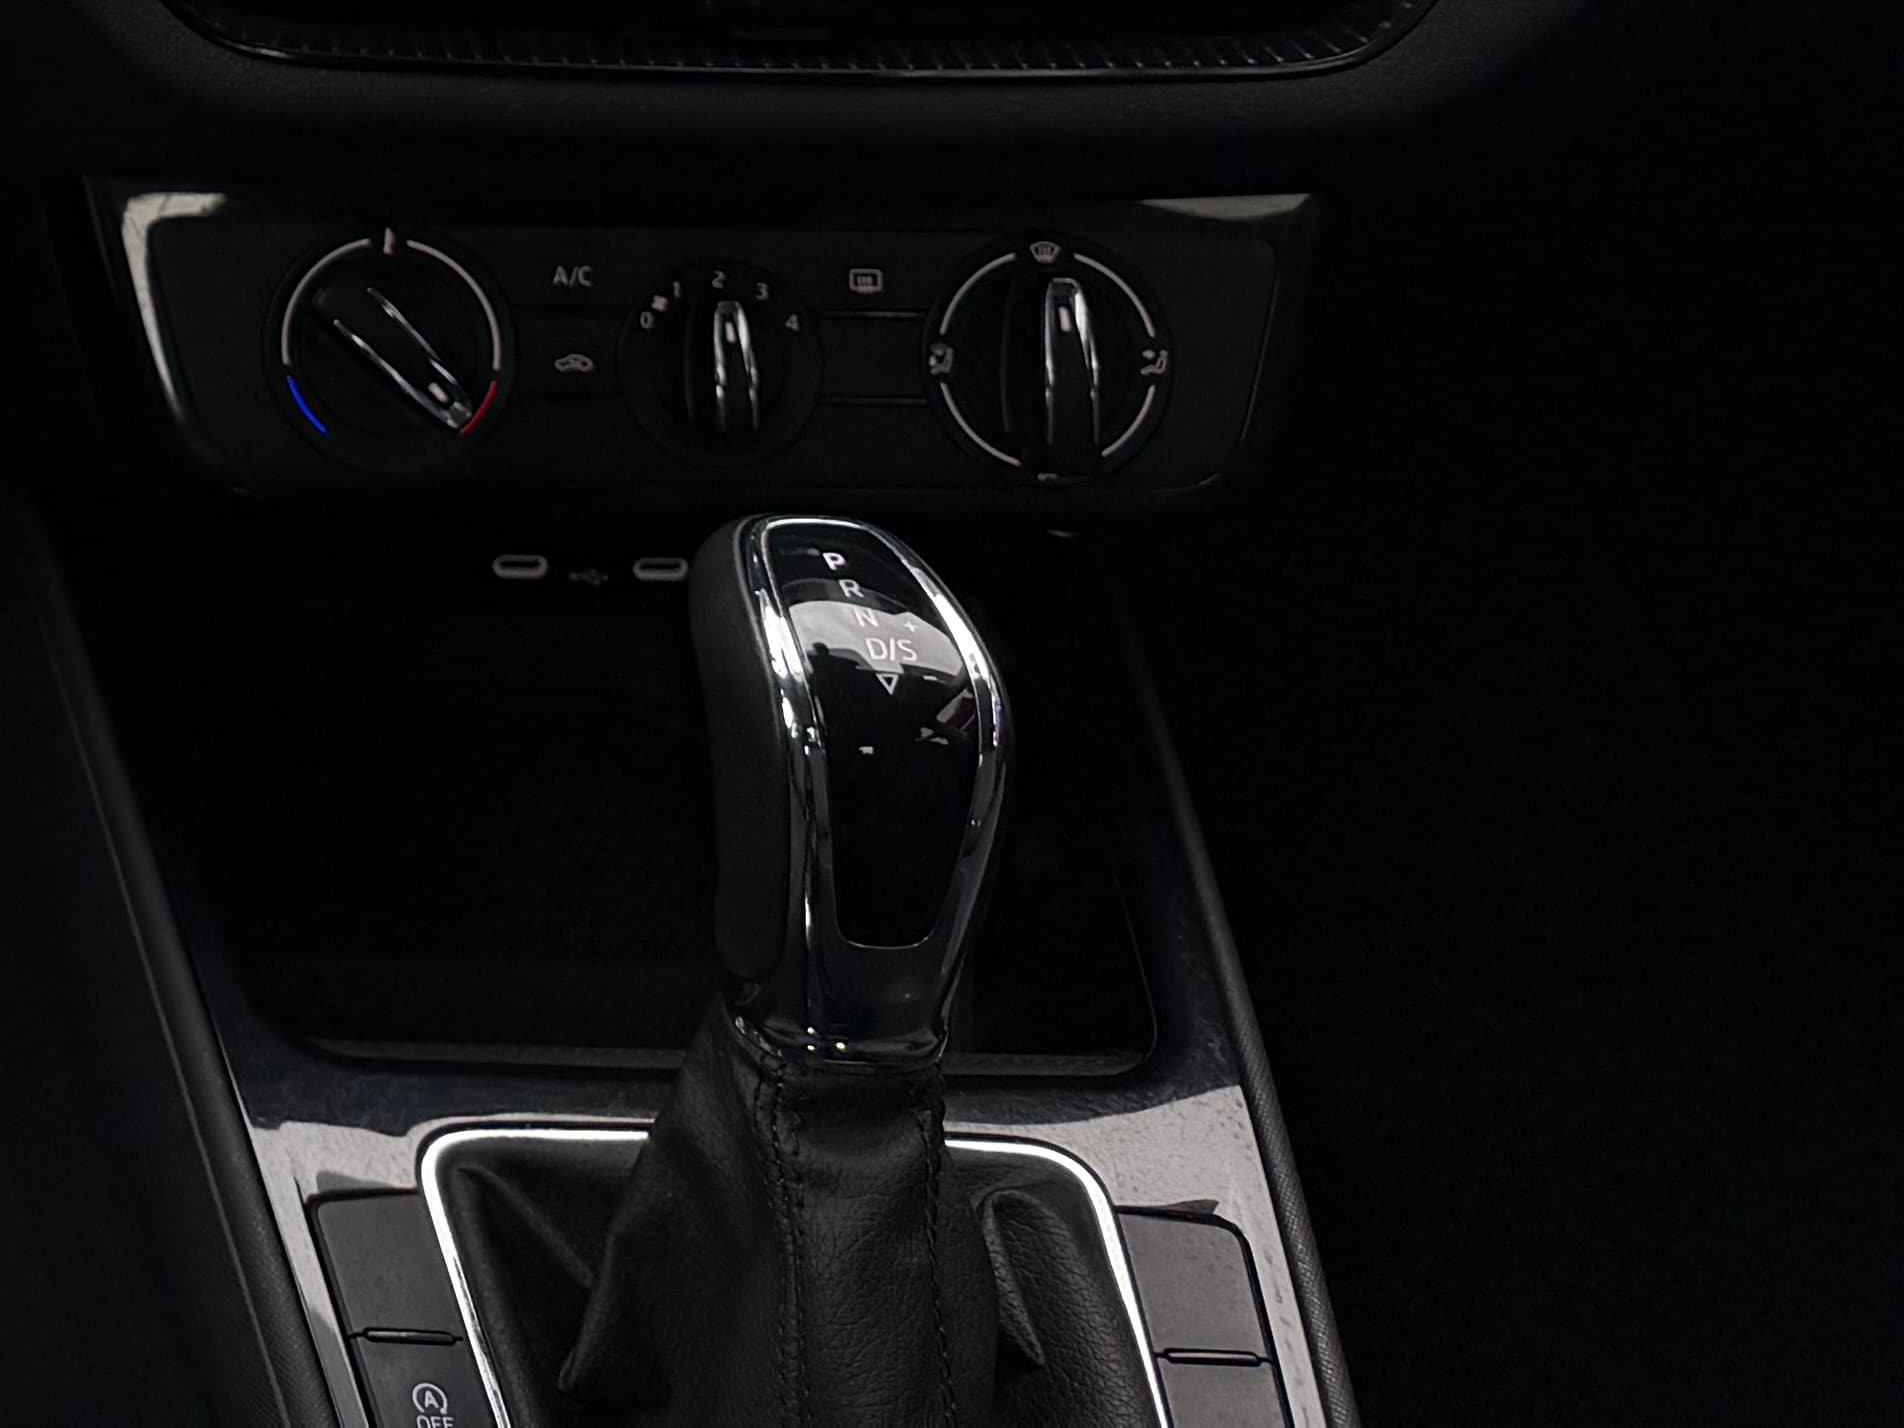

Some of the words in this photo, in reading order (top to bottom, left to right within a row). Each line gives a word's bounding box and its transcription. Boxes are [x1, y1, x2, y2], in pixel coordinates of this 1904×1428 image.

[552, 264, 593, 287] A/C
[711, 270, 726, 289] 2
[755, 281, 769, 301] 3
[784, 313, 800, 332] 4
[822, 552, 848, 572] P
[839, 578, 865, 599] R
[854, 608, 879, 628] N
[865, 637, 919, 662] D/S
